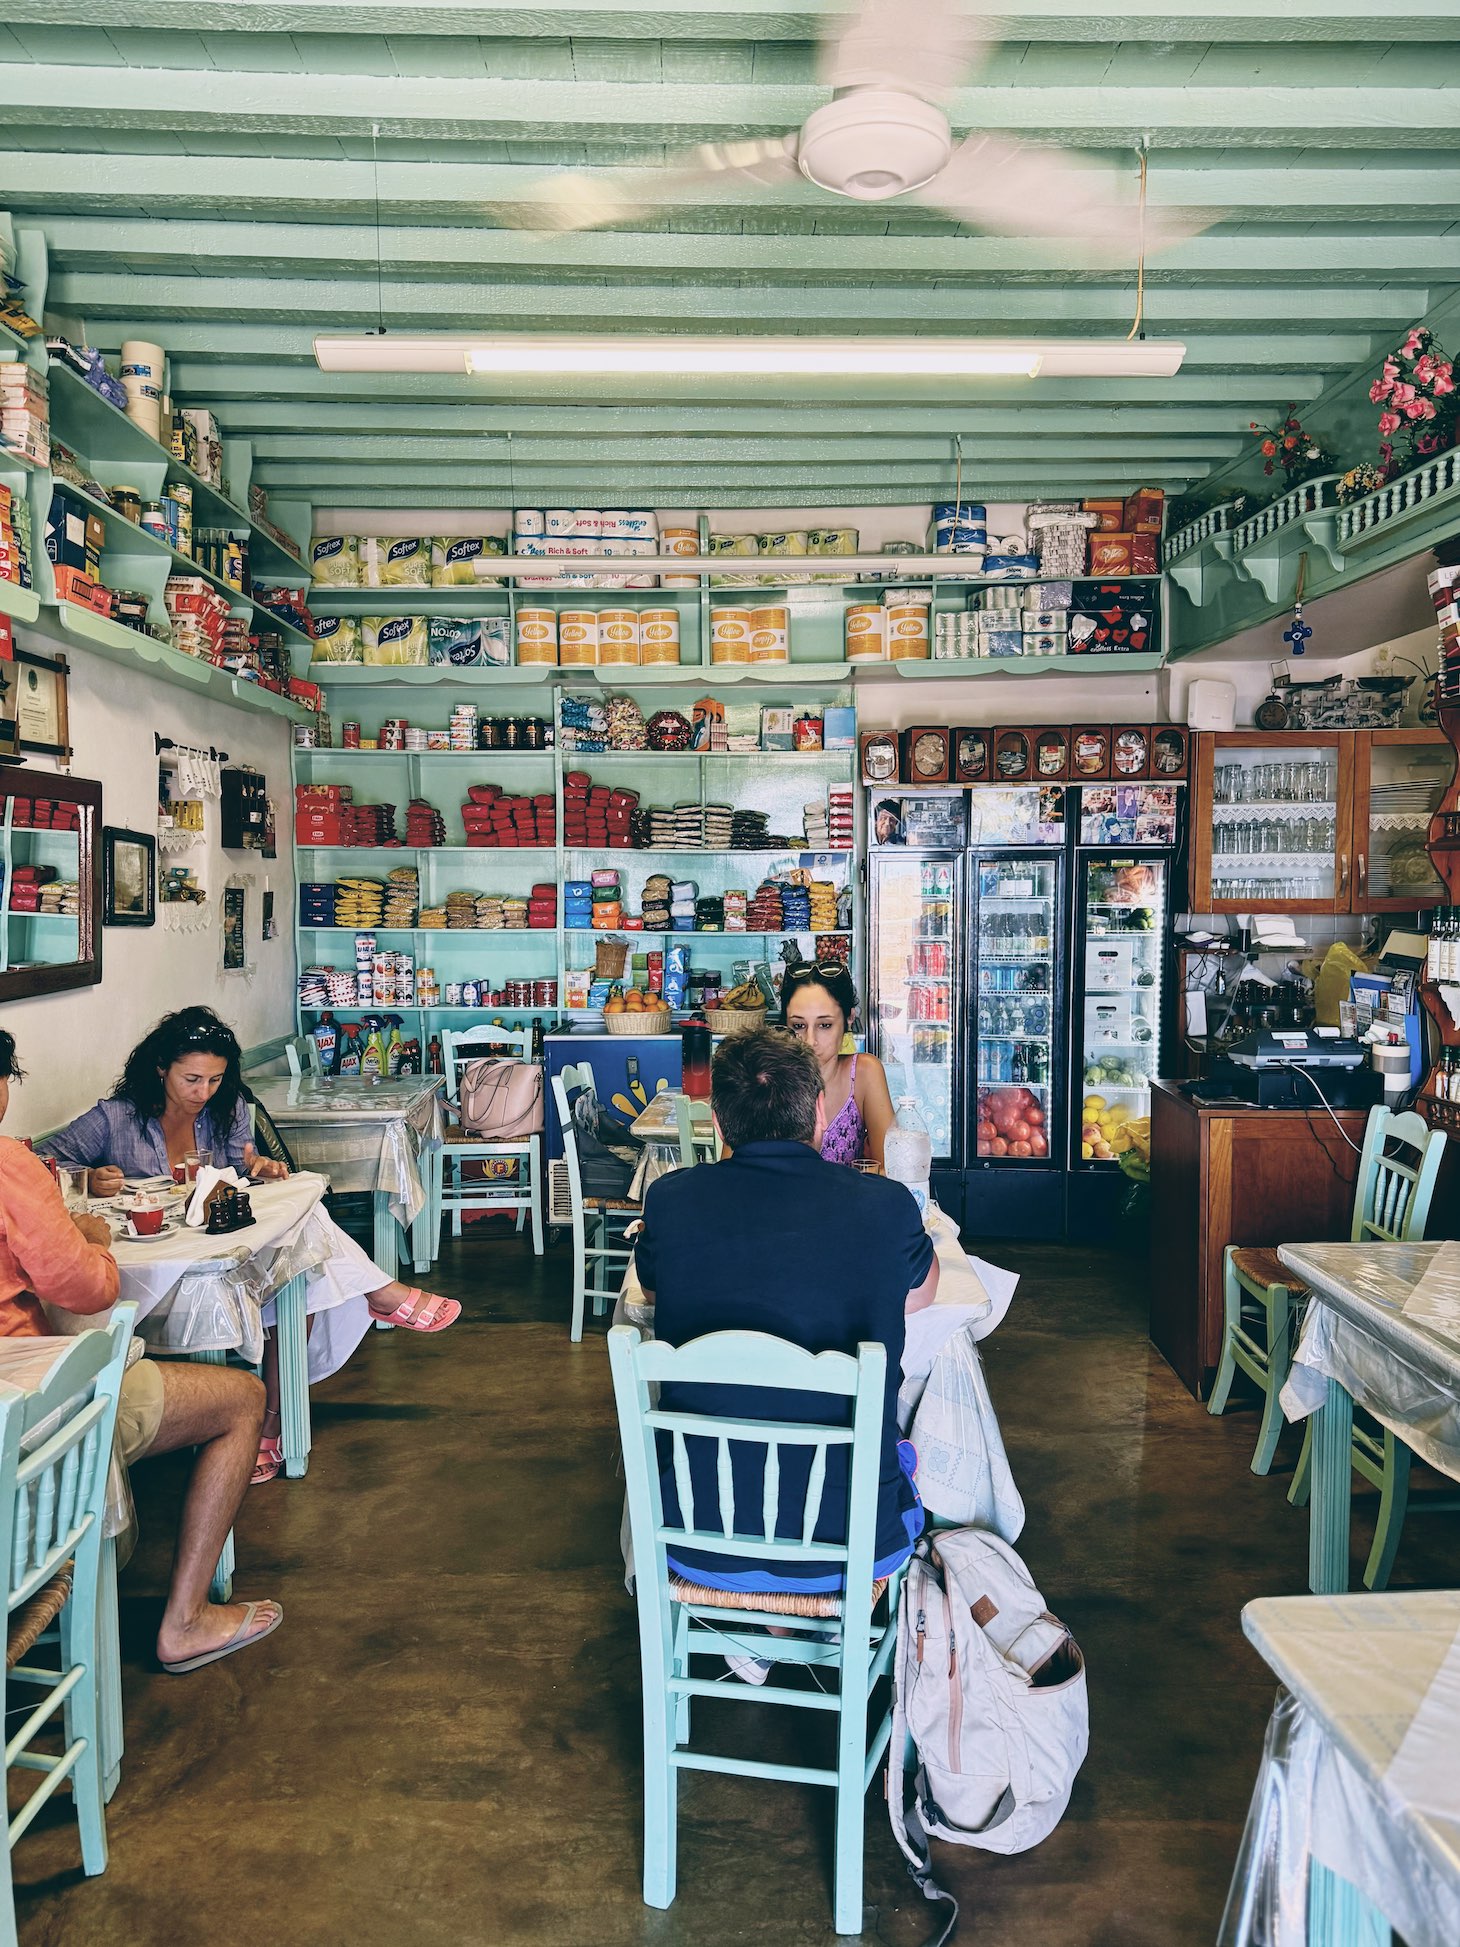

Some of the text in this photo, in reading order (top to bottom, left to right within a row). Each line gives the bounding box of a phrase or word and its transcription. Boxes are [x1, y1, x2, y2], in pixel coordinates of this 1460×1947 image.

[575, 519, 592, 527] Soft
[600, 520, 616, 528] Rich
[618, 519, 647, 531] endless
[317, 539, 341, 556] Softex
[392, 540, 417, 556] Softex
[451, 542, 480, 558] Softex
[572, 547, 588, 555] Soft
[330, 568, 351, 576] SOFT
[405, 568, 426, 576] SOFT
[314, 618, 337, 633] oftex
[383, 621, 410, 639] Softex
[333, 645, 354, 653] SOFT
[342, 1057, 357, 1068] AJAX
